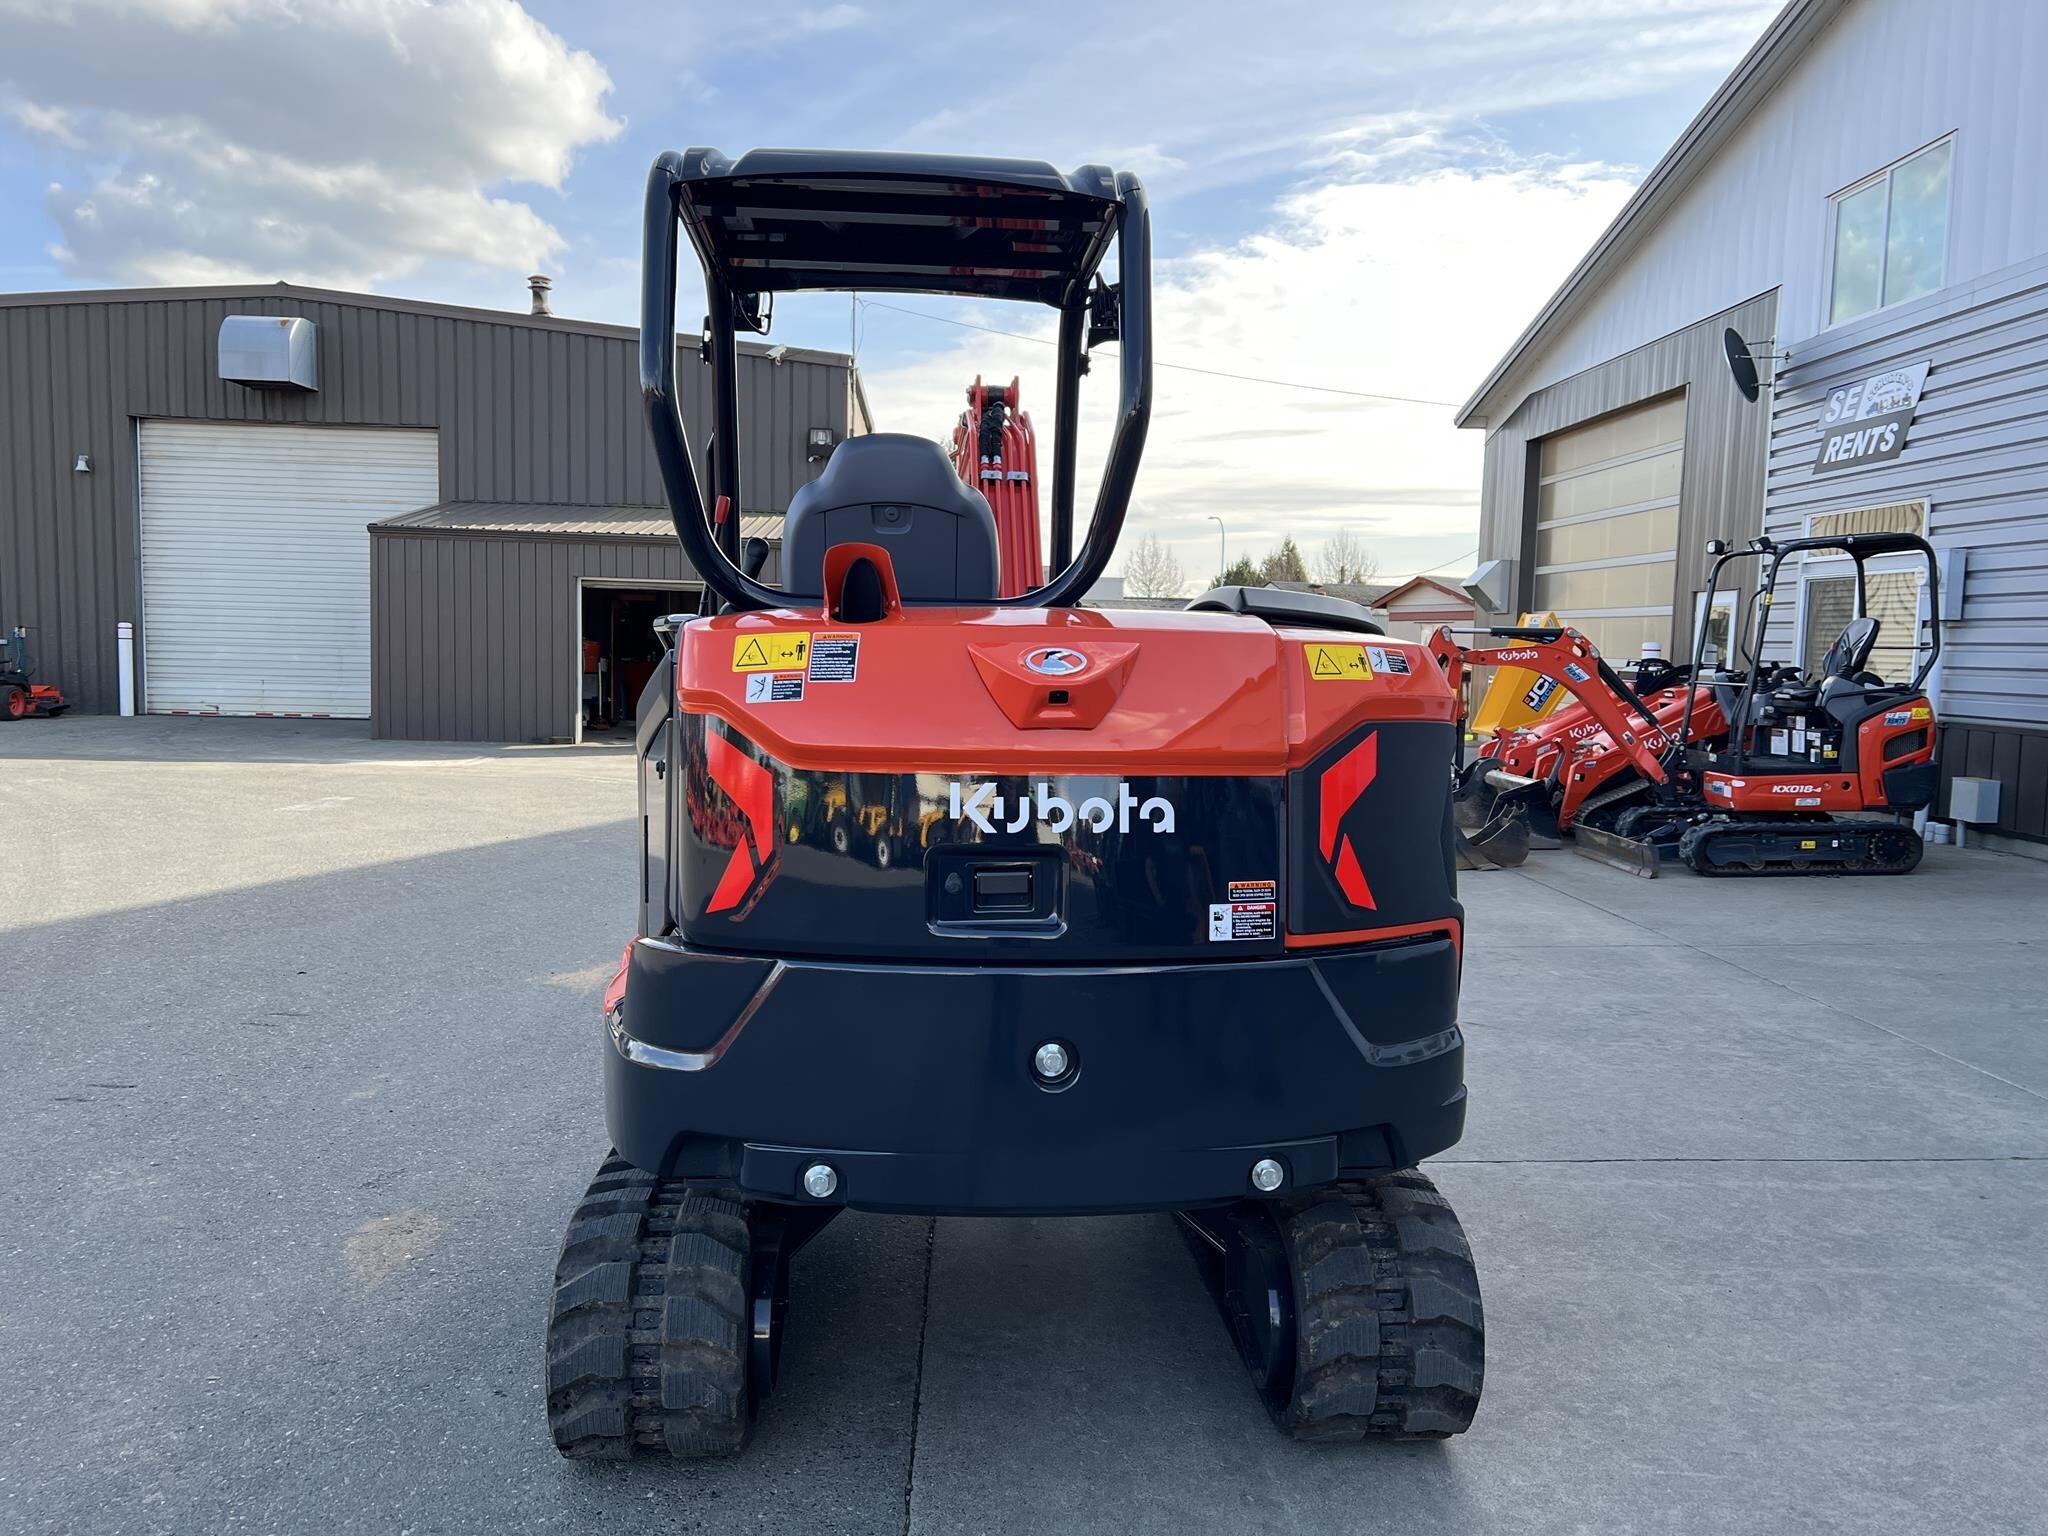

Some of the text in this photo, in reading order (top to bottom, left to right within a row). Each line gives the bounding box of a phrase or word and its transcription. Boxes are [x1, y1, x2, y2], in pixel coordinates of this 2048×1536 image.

[1825, 385, 1863, 422] SE
[1823, 422, 1899, 464] RENTS
[1497, 649, 1539, 661] Kubota
[1569, 722, 1603, 738] Kubo
[1772, 785, 1822, 793] KX018-4
[949, 782, 1176, 834] Kubota
